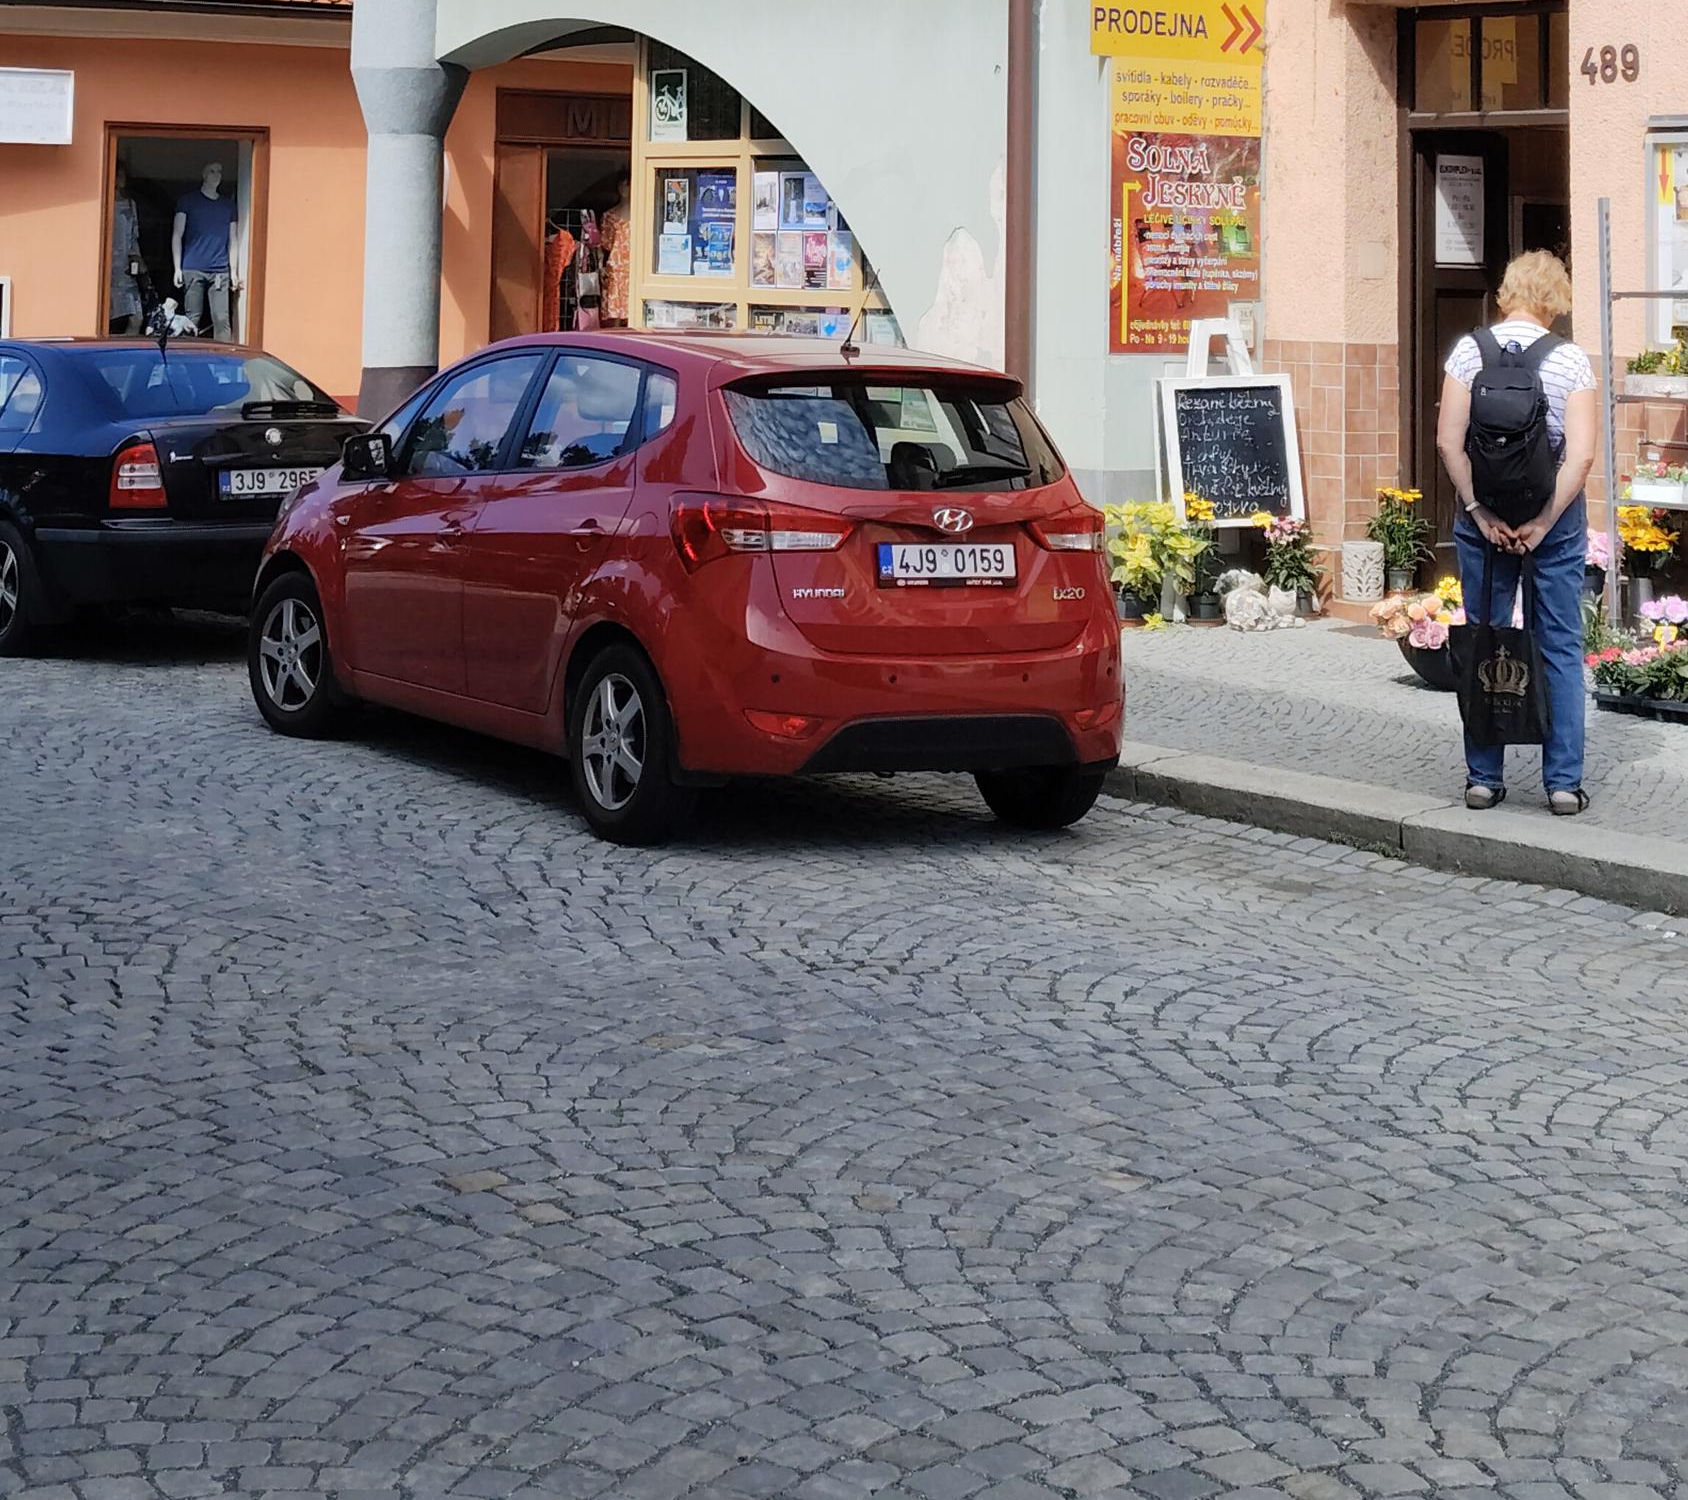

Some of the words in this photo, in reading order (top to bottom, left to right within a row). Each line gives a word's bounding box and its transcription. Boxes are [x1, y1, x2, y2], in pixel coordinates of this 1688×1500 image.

[1094, 6, 1208, 40] PRODEJNA
[1580, 43, 1640, 86] 489
[1116, 70, 1152, 85] svítidla
[1160, 72, 1192, 89] kabely
[1122, 91, 1162, 106] sporáky
[1115, 112, 1152, 126] pracovní
[1154, 112, 1175, 125] obuv
[1127, 137, 1211, 174] SOLNÁ
[235, 472, 266, 491] 3J9
[881, 565, 893, 574] CZ
[899, 548, 937, 573] 4J9
[954, 548, 1005, 573] 0159
[793, 588, 845, 599] HYUNDAI
